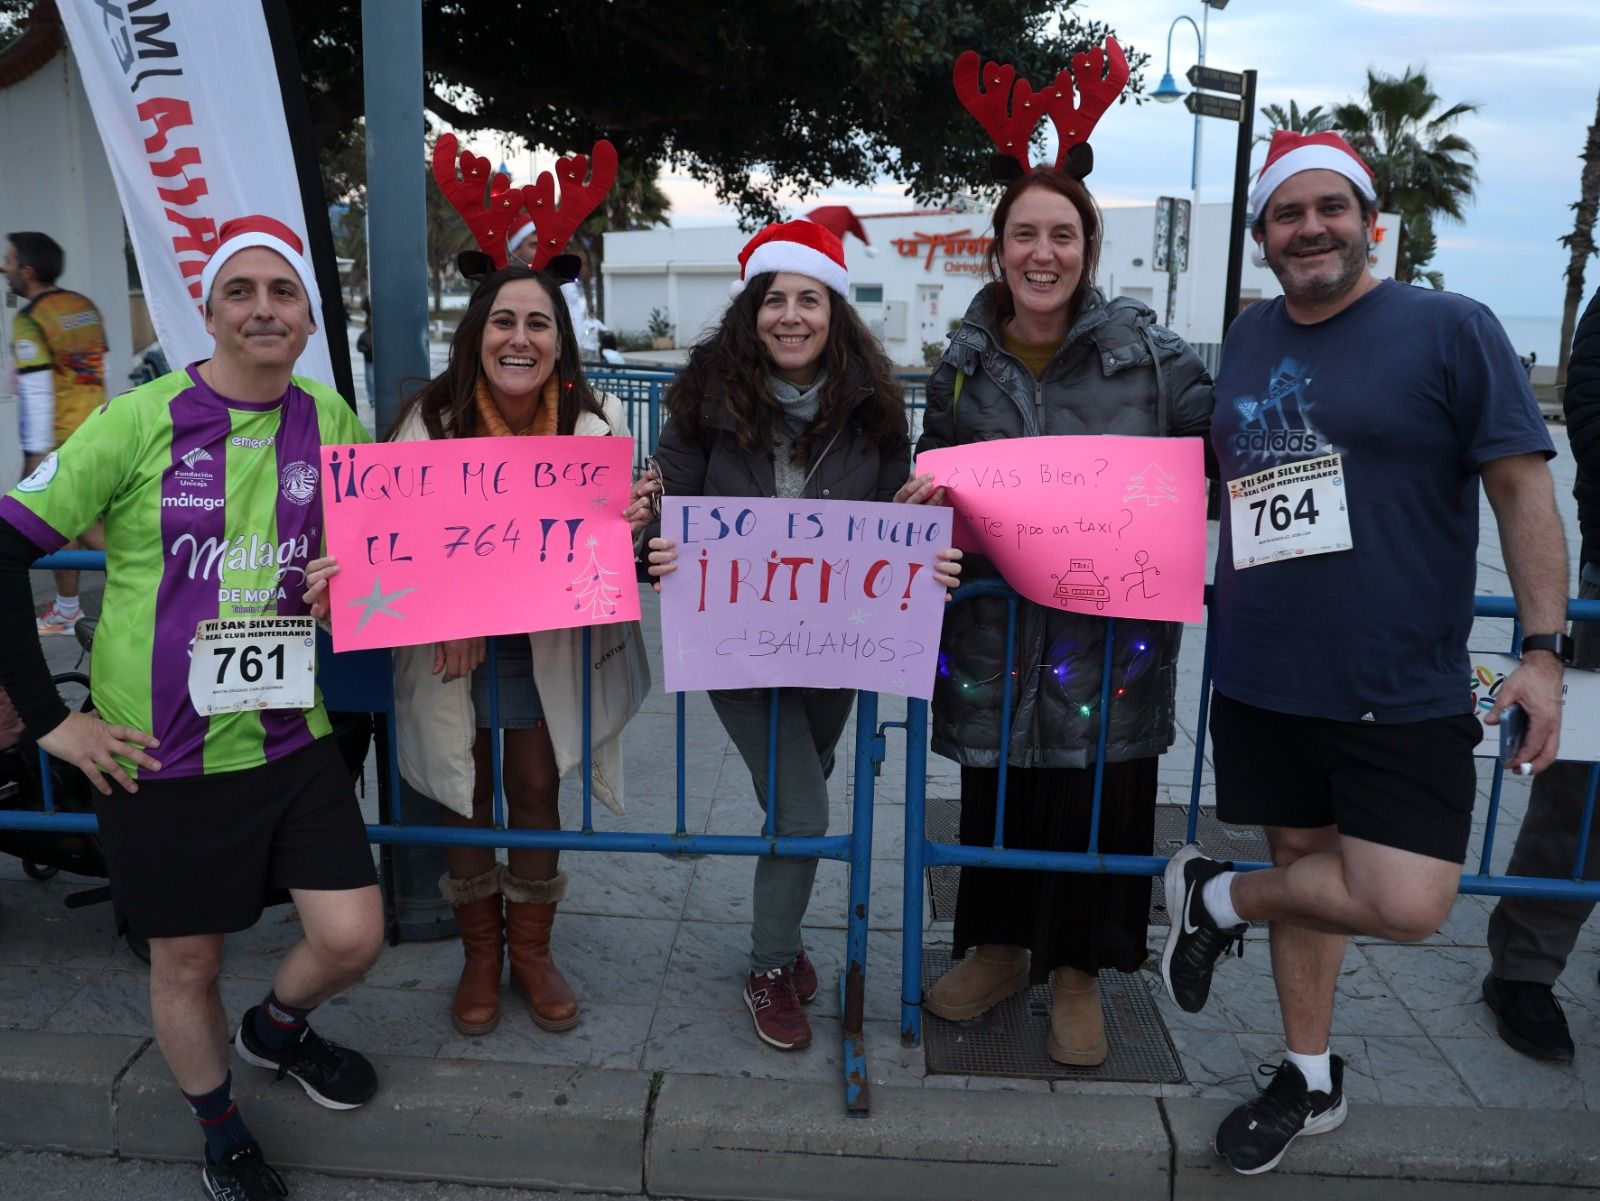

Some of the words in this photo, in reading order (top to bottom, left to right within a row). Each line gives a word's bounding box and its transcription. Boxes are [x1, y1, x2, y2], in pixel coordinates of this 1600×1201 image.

[1235, 429, 1318, 452] adidas
[174, 470, 213, 479] Fundación
[180, 479, 208, 488] Unicaja
[462, 461, 510, 501] ME
[534, 461, 610, 489] BESE
[1241, 480, 1255, 489] VII
[1257, 471, 1275, 484] SAN
[1277, 457, 1339, 478] SILVESTRE
[1243, 488, 1260, 497] REAL
[1260, 483, 1276, 492] CLUB
[681, 505, 757, 544] ESO
[787, 511, 824, 539] ES
[847, 514, 941, 547] MUCHO
[1249, 488, 1320, 537] 764
[171, 532, 308, 587] Málaga
[219, 588, 241, 602] DE
[206, 623, 218, 632] VII
[220, 621, 246, 630] SAN
[249, 619, 313, 629] SILVESTRE
[213, 643, 285, 684] 761
